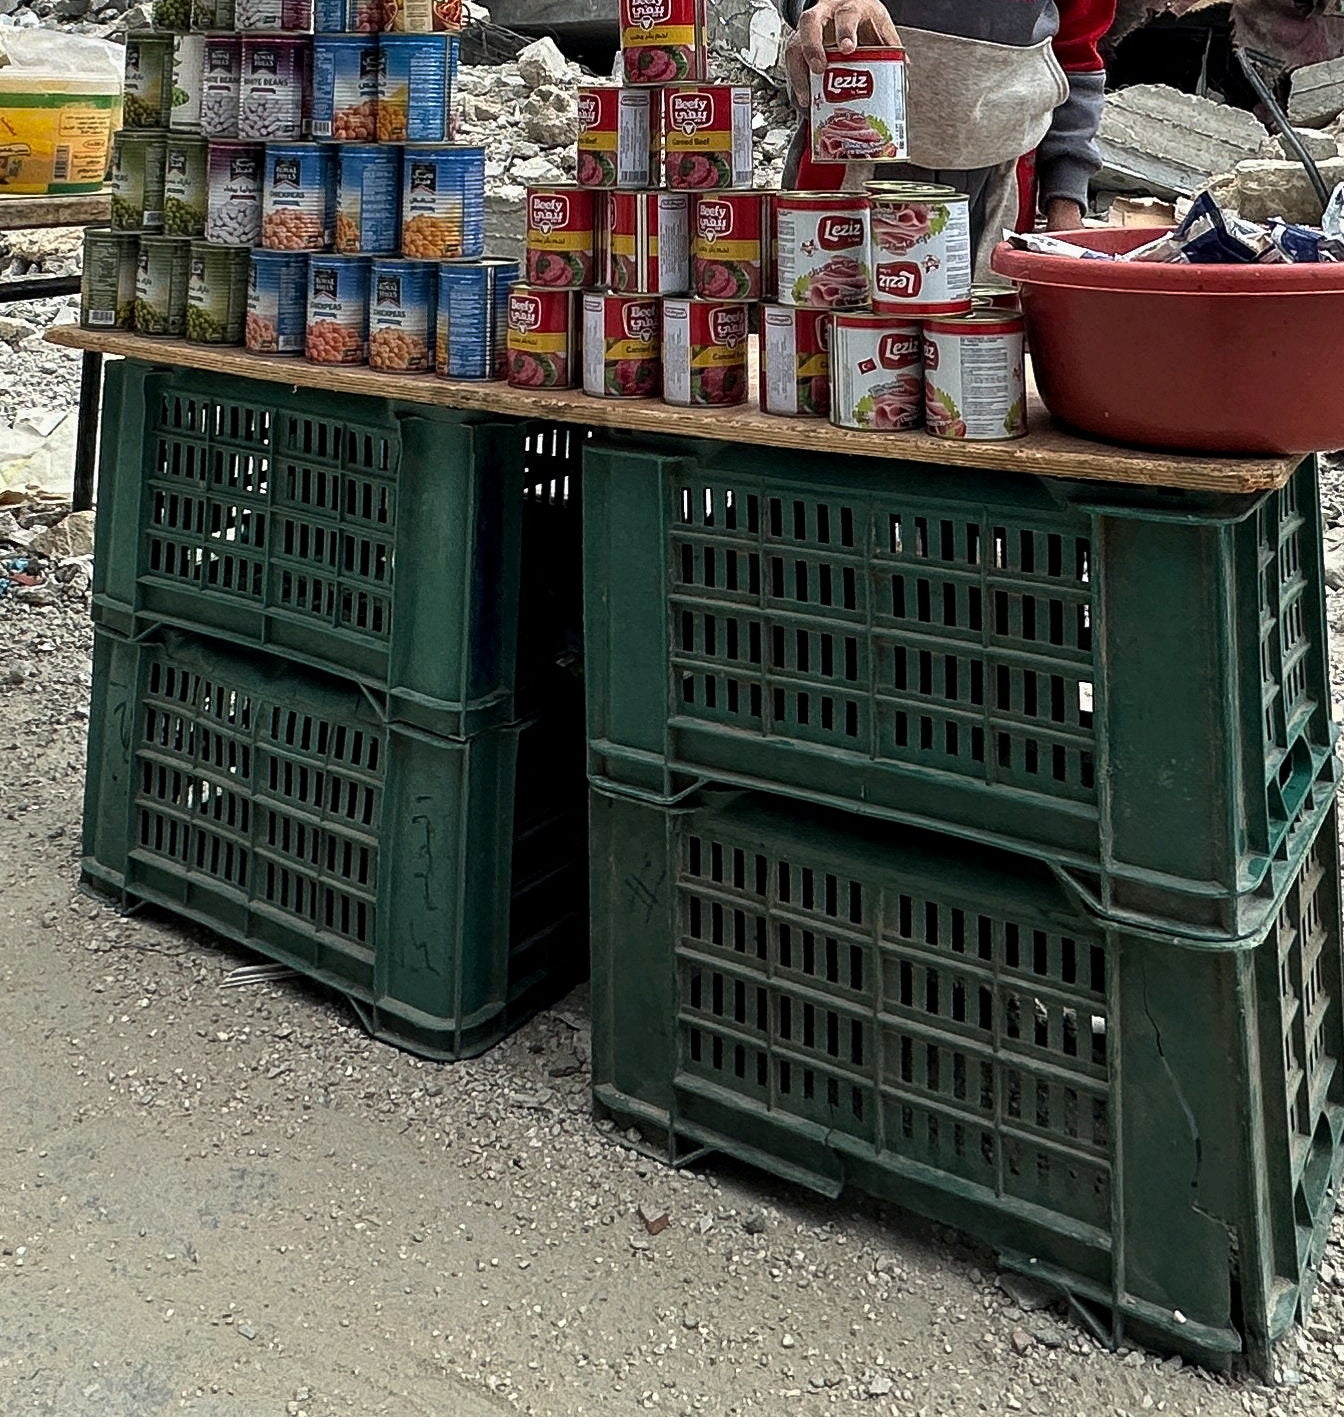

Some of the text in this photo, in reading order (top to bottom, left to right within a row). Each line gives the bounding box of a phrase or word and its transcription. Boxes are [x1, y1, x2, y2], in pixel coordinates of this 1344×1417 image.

[827, 71, 868, 94] Leziz
[675, 97, 708, 111] Beefy
[533, 198, 563, 212] Beefy
[699, 205, 727, 217] Beefy
[824, 220, 862, 242] Leziz
[879, 271, 915, 294] Leziz
[511, 298, 536, 313] Beefy
